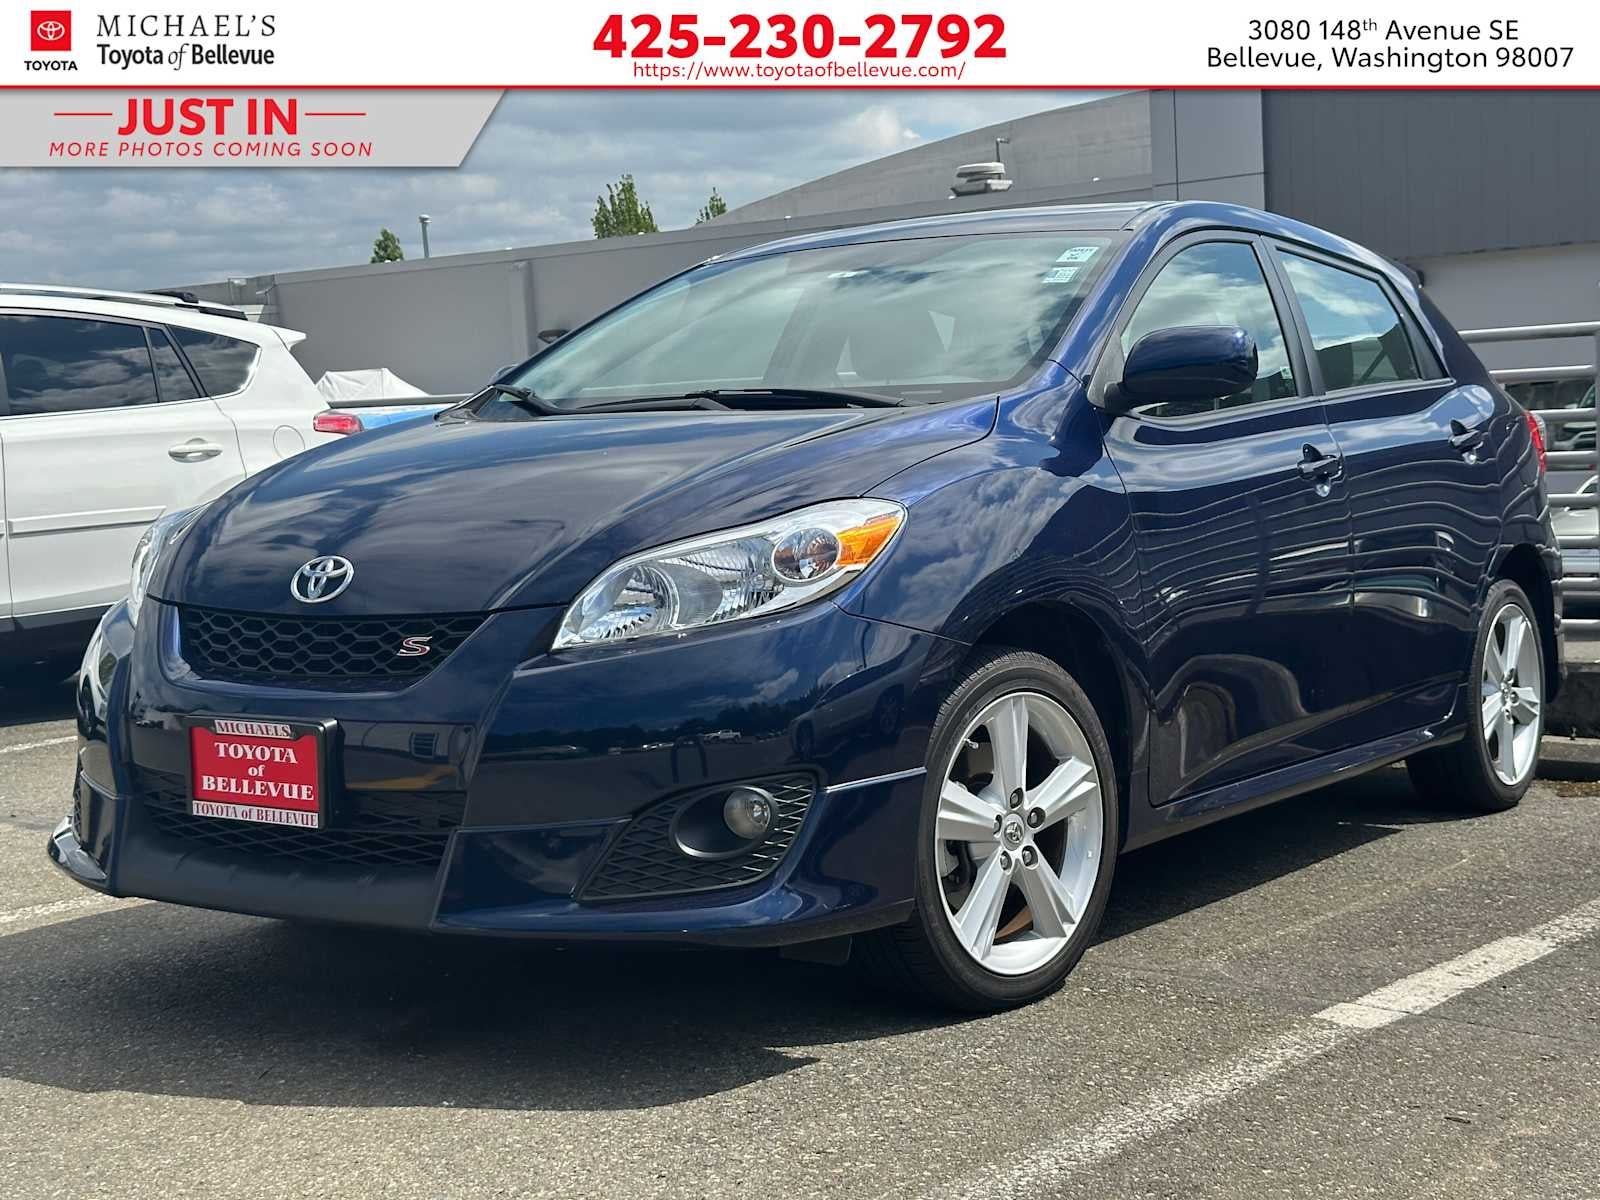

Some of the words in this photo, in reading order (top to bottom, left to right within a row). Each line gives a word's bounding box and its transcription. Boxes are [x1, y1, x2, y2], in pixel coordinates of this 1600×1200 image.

[216, 721, 291, 738] MICHAELS
[214, 742, 298, 764] TOYOTA
[248, 764, 265, 777] of
[202, 775, 314, 801] BELLEVUE
[193, 802, 239, 819] TOYOTA
[256, 808, 318, 827] BELLEVUE
